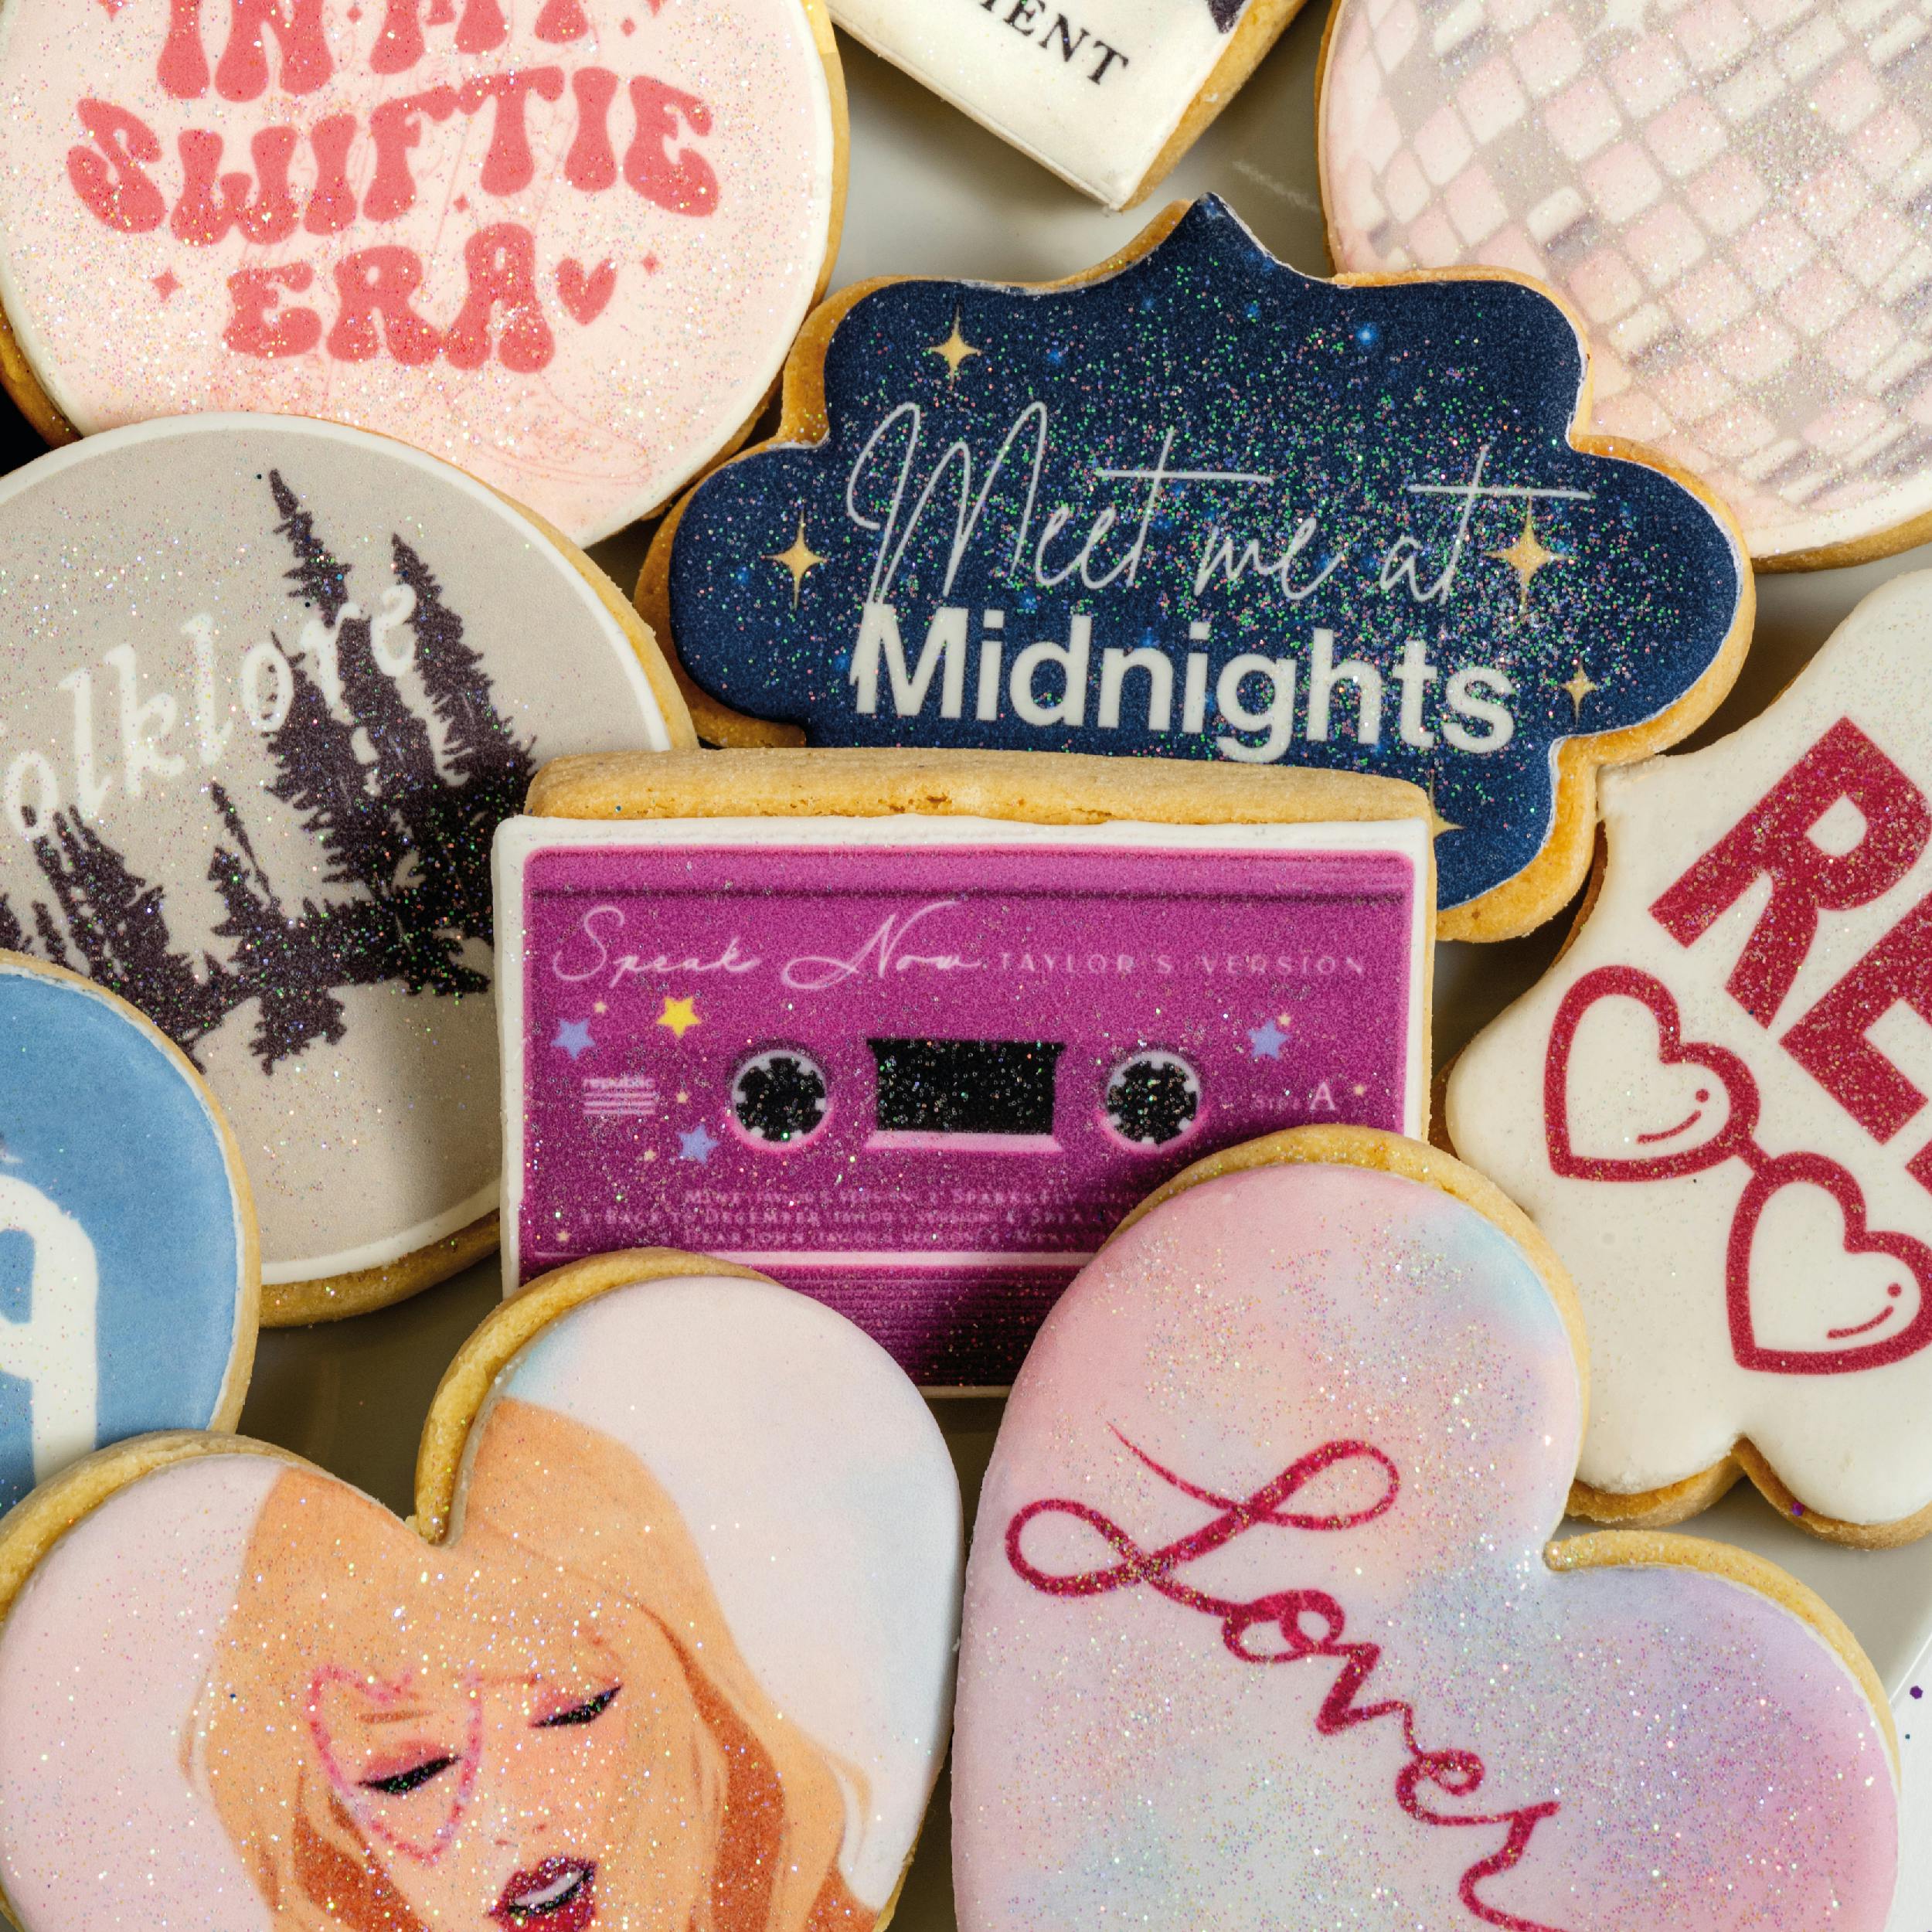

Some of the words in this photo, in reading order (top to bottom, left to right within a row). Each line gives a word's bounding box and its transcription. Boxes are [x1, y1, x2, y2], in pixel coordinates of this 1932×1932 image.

[980, 0, 1129, 85] ENT
[66, 66, 720, 247] SWIFTIE
[221, 223, 556, 374] ERA
[846, 401, 1274, 607] Meet
[1193, 515, 1343, 600] me
[1381, 444, 1591, 604] at
[0, 583, 415, 838] olklore
[849, 602, 1516, 764] Midnights
[553, 905, 764, 989] Speak
[781, 900, 982, 990] Now
[1201, 953, 1365, 975] VERSION
[1648, 716, 1932, 1196] RE
[1309, 1081, 1338, 1111] A
[1005, 1421, 1569, 1932] Lover
